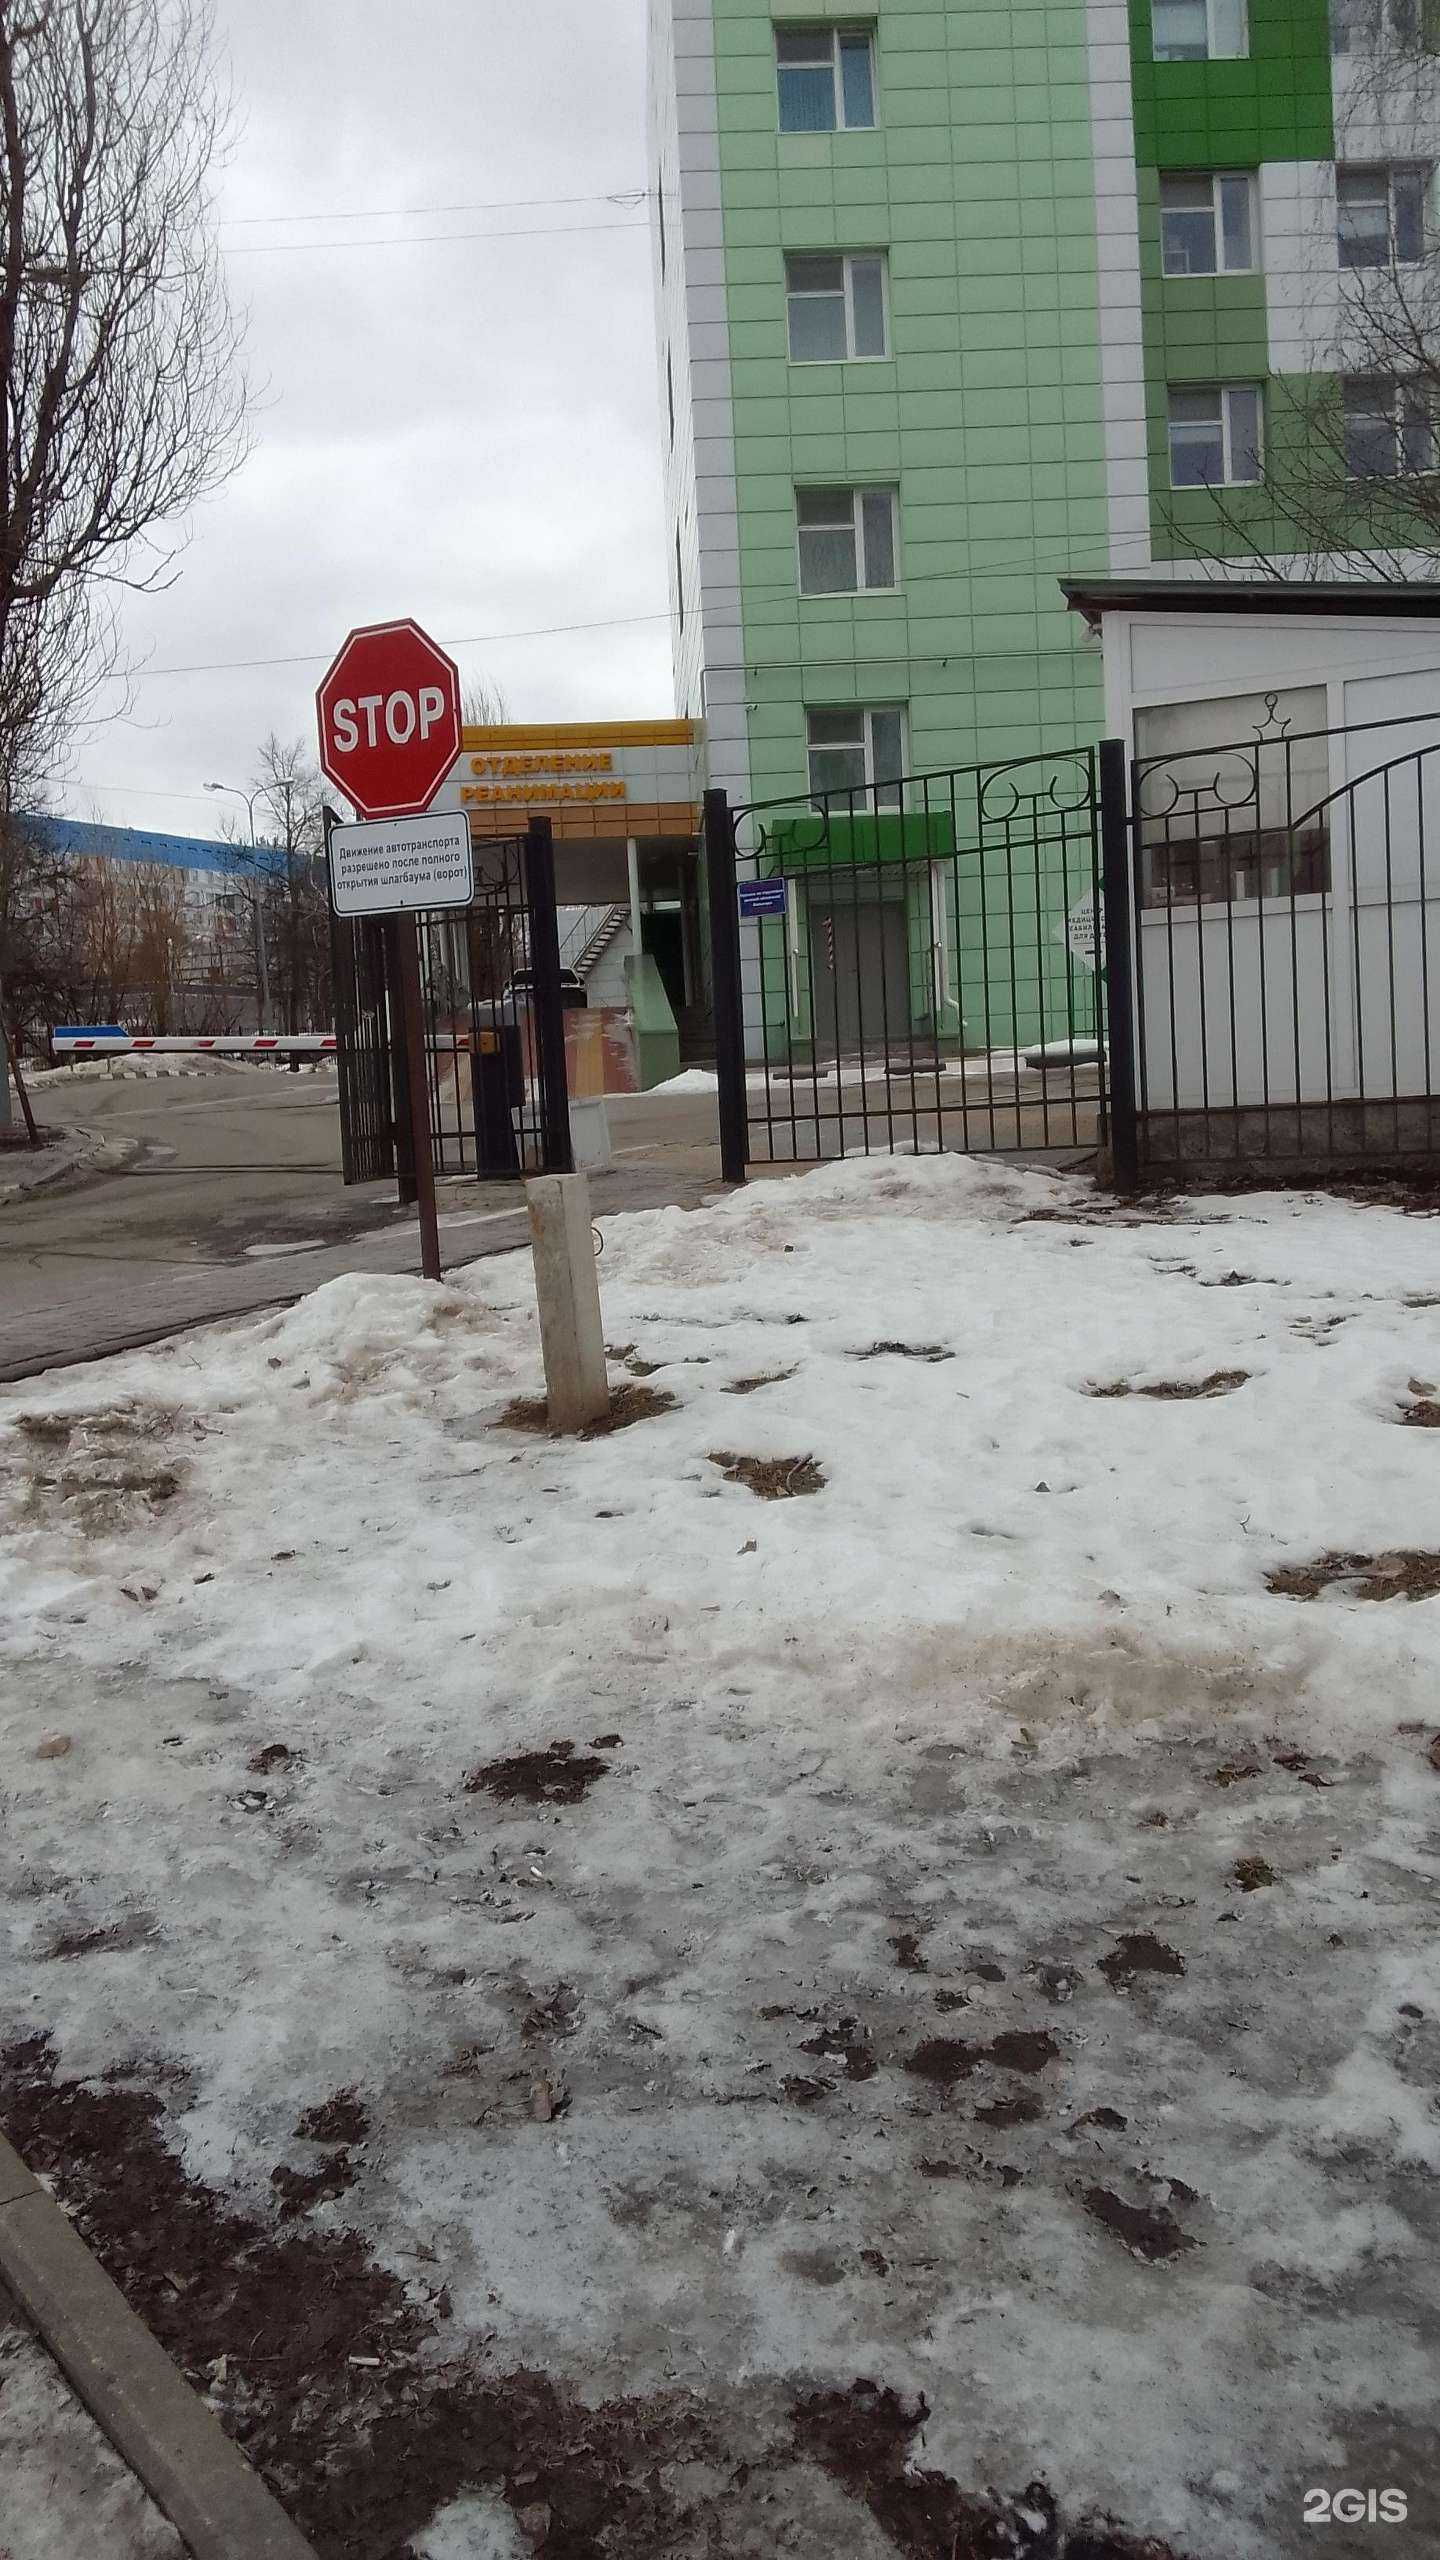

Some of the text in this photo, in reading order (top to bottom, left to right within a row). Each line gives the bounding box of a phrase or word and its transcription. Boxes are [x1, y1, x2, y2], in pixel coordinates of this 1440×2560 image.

[333, 687, 444, 752] STOP
[470, 752, 613, 776] ОТДЕЛЕНИЕ
[460, 780, 626, 804] РЕАНИМАЦИИ
[339, 836, 461, 861] Движение автотранспорта
[341, 852, 461, 877] разрешено после полного
[336, 865, 468, 891] открытия шлагбаума (ворот)
